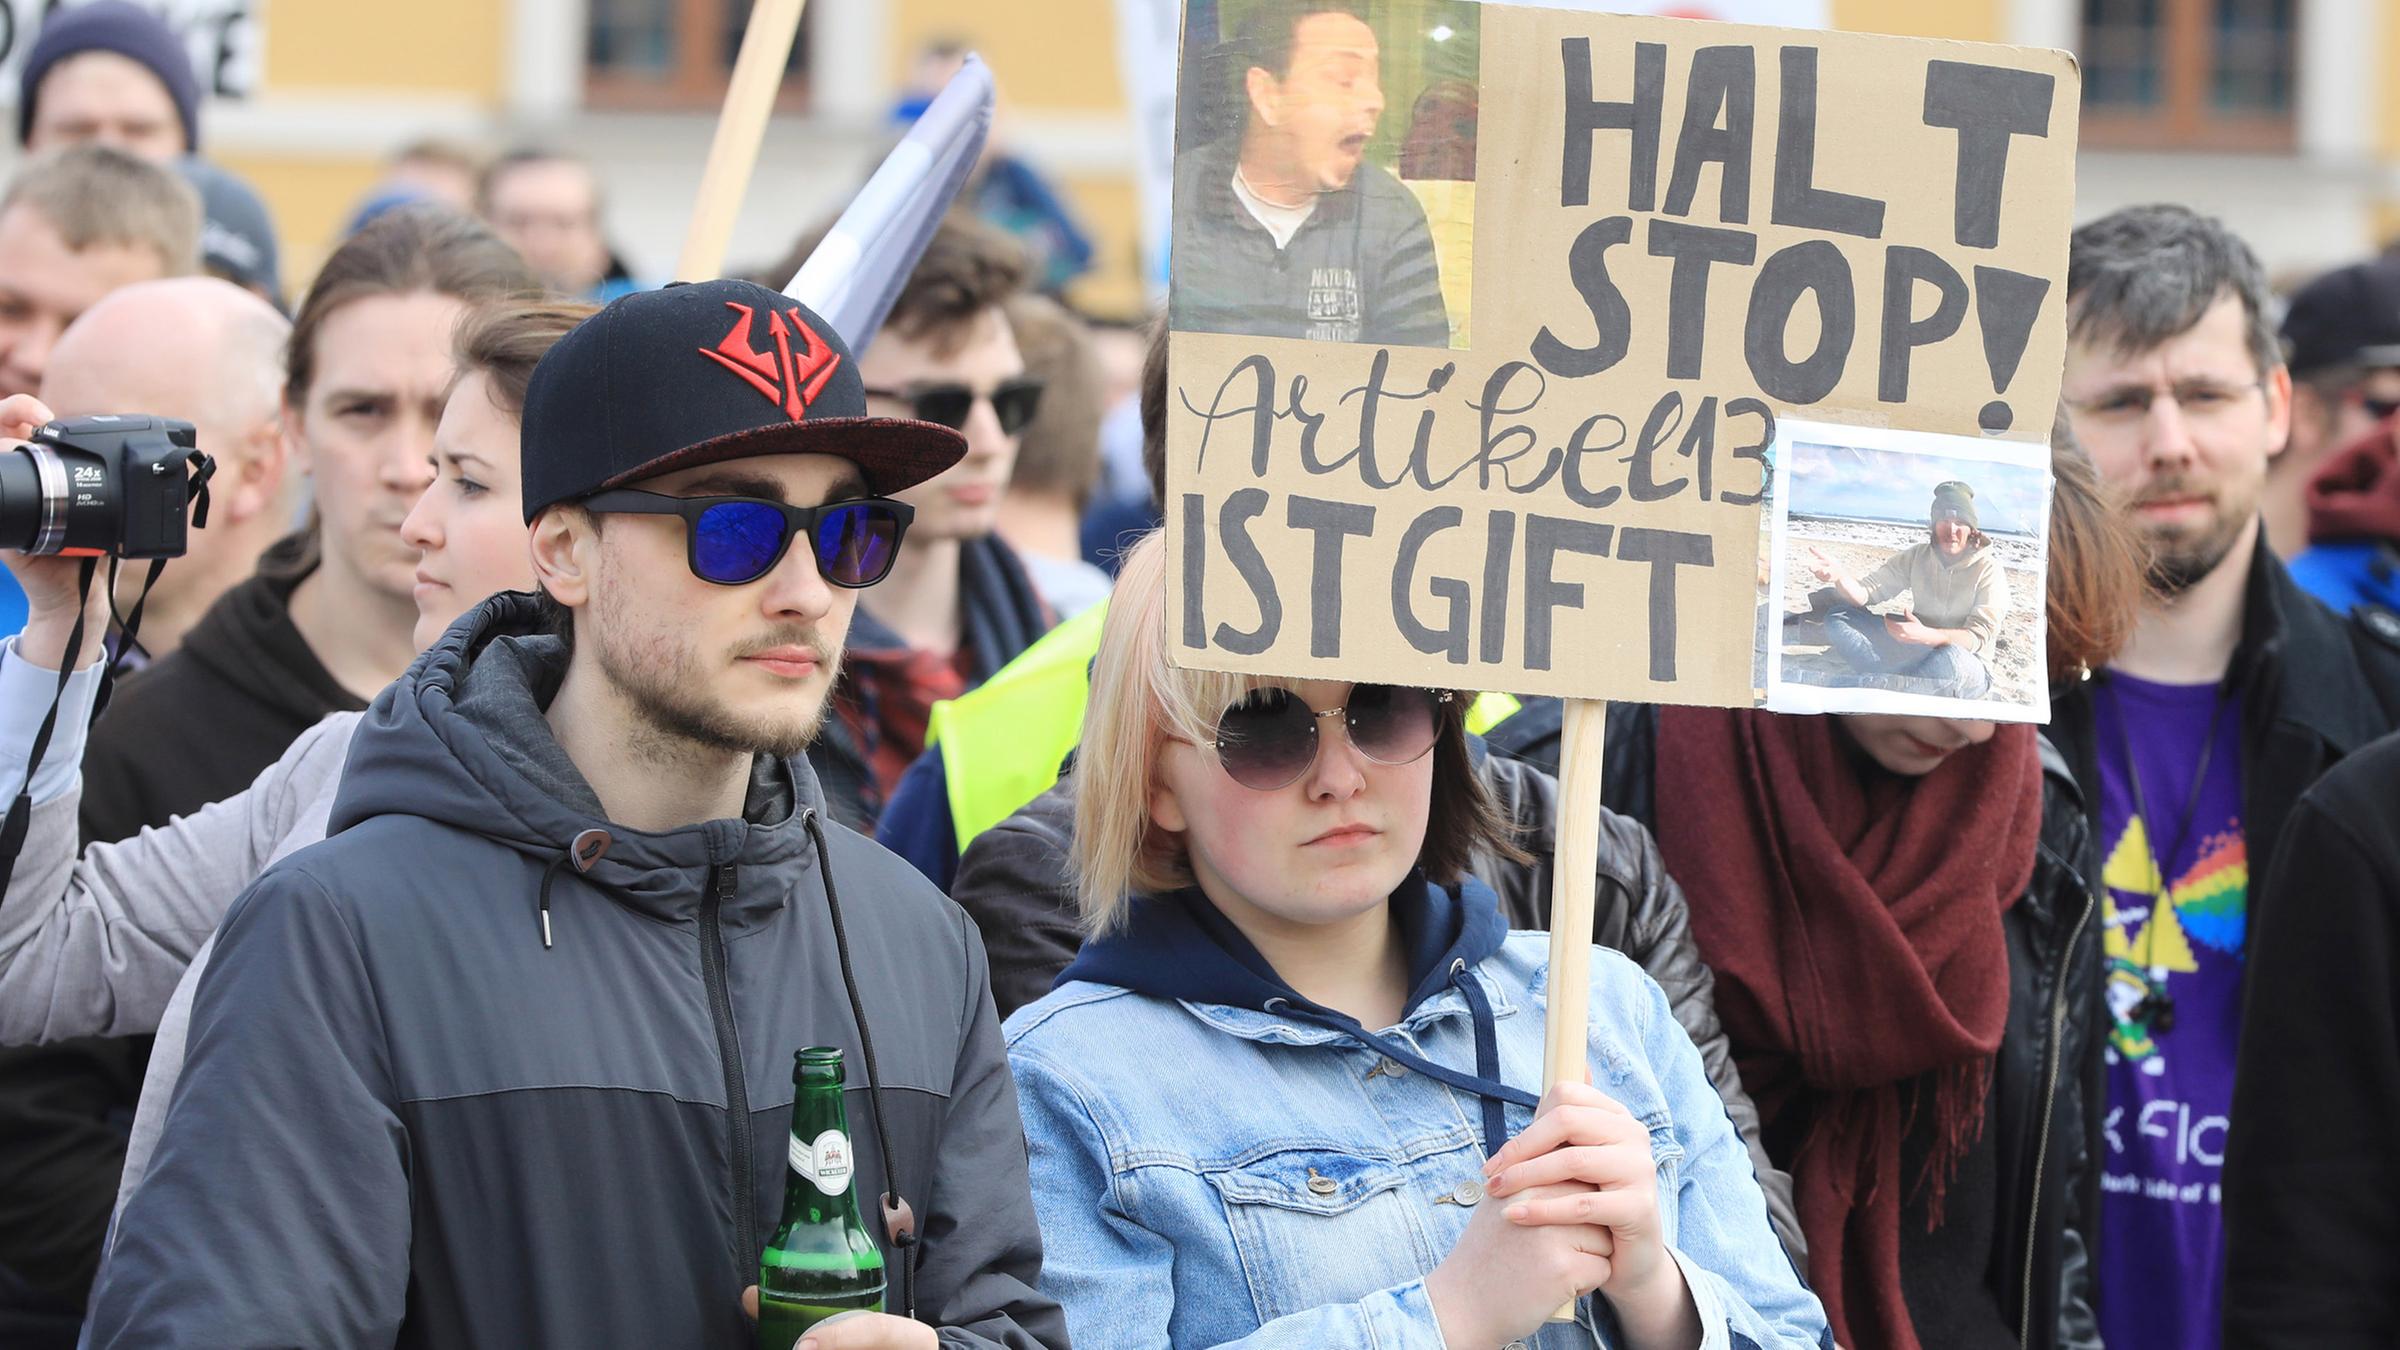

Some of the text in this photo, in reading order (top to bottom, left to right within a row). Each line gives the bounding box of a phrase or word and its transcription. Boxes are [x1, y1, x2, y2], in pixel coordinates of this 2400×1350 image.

[1561, 36, 2055, 249] HALT
[1530, 216, 2051, 436] STOP!
[74, 466, 101, 478] 24x
[1182, 488, 1715, 682] IST GIFT
